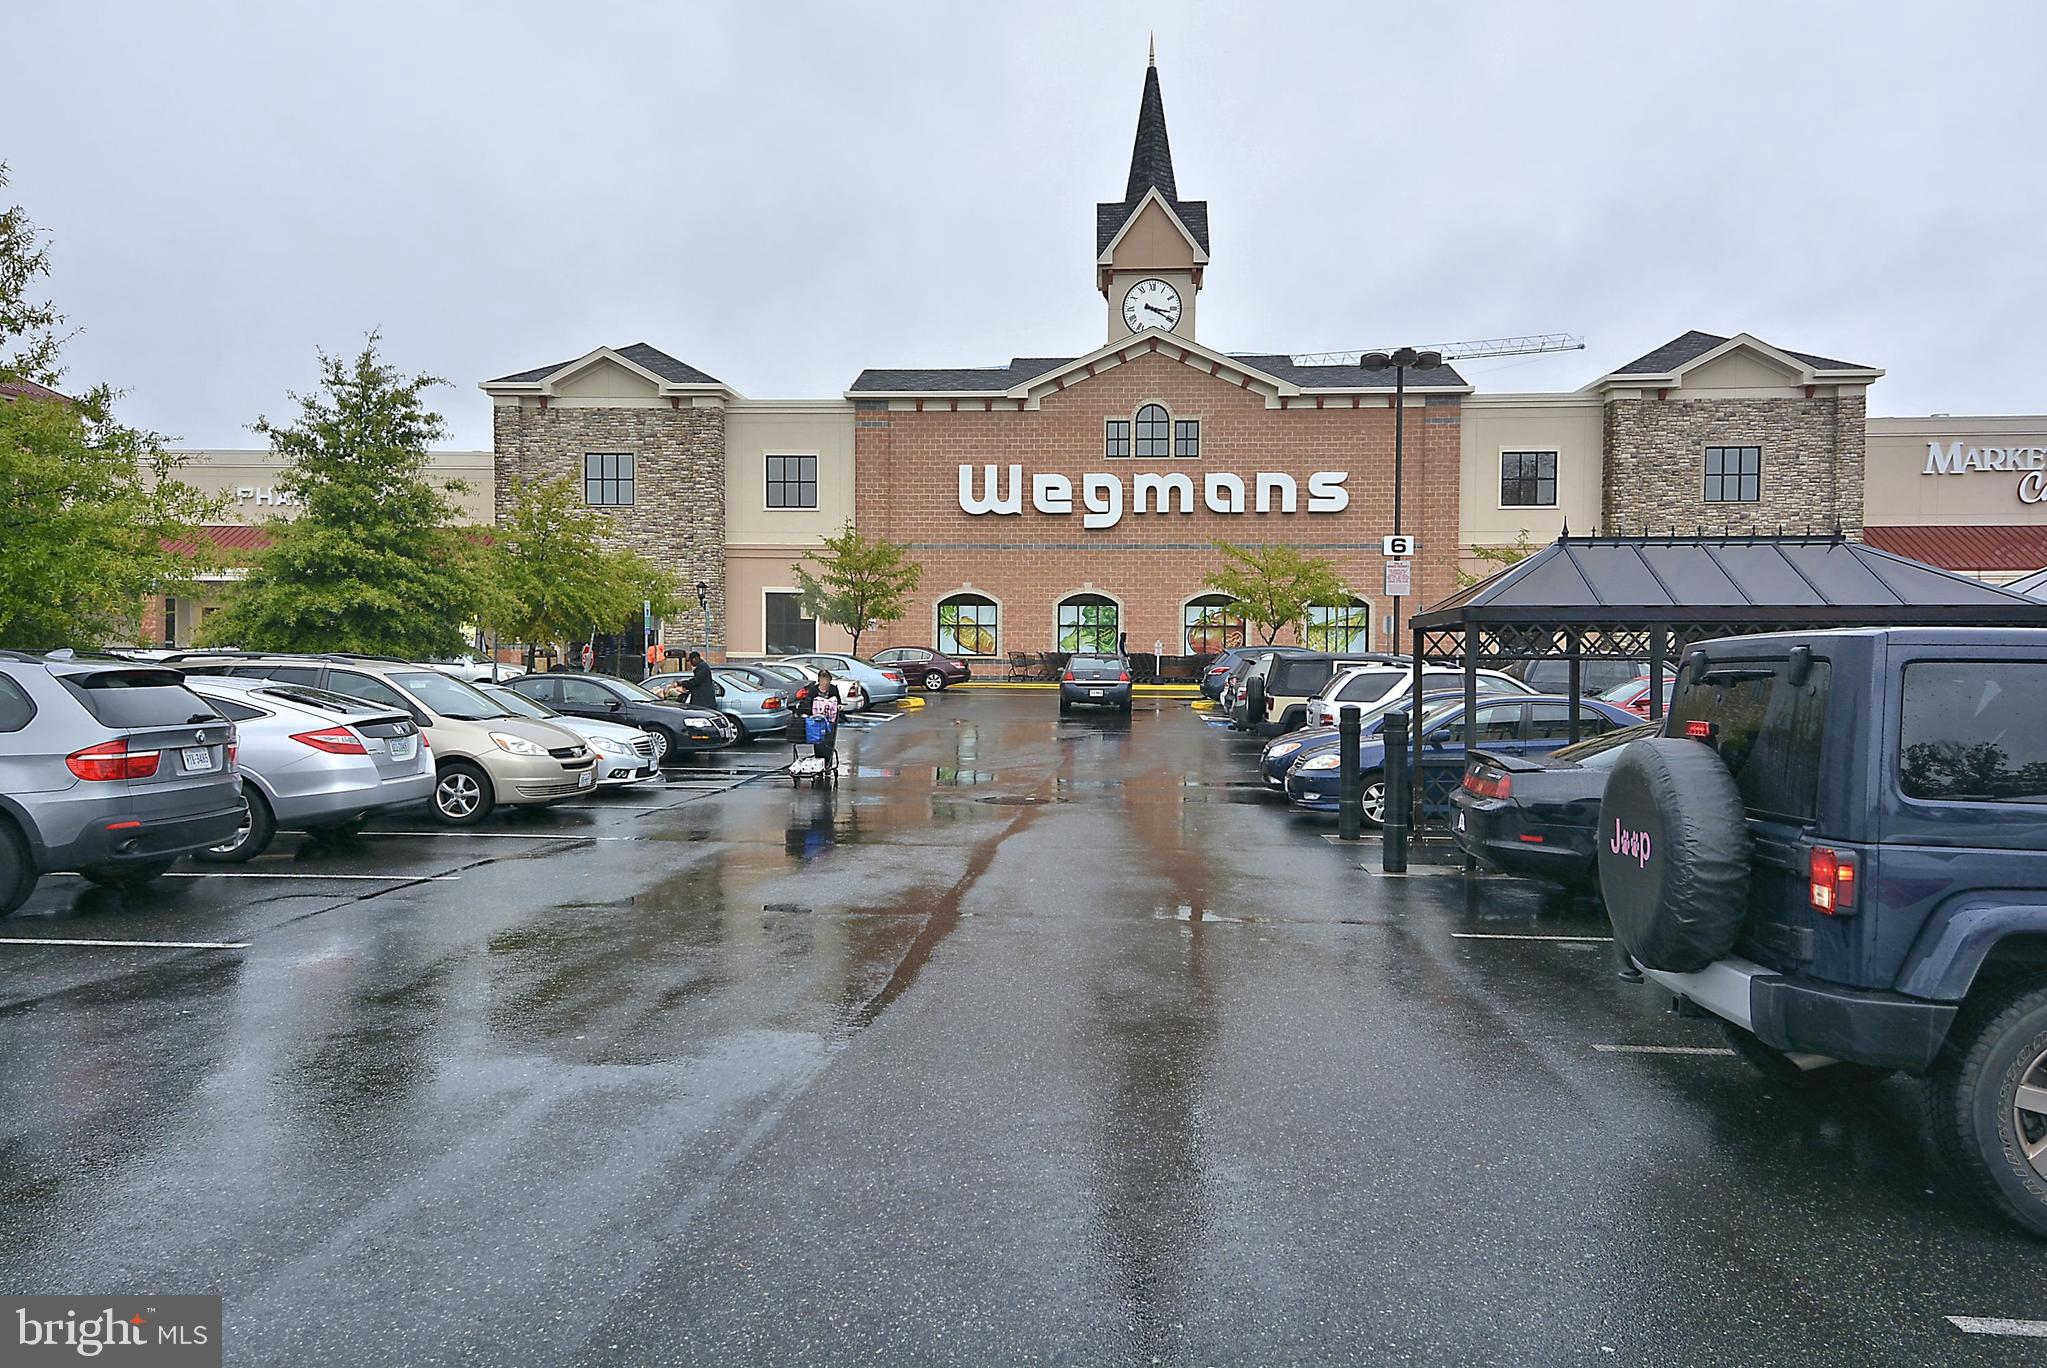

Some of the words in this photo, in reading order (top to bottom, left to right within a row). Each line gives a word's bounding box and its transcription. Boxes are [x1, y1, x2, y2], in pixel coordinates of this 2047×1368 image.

[1922, 442, 2047, 474] MARKE
[958, 464, 1350, 529] Wegmans
[1391, 538, 1407, 554] 6
